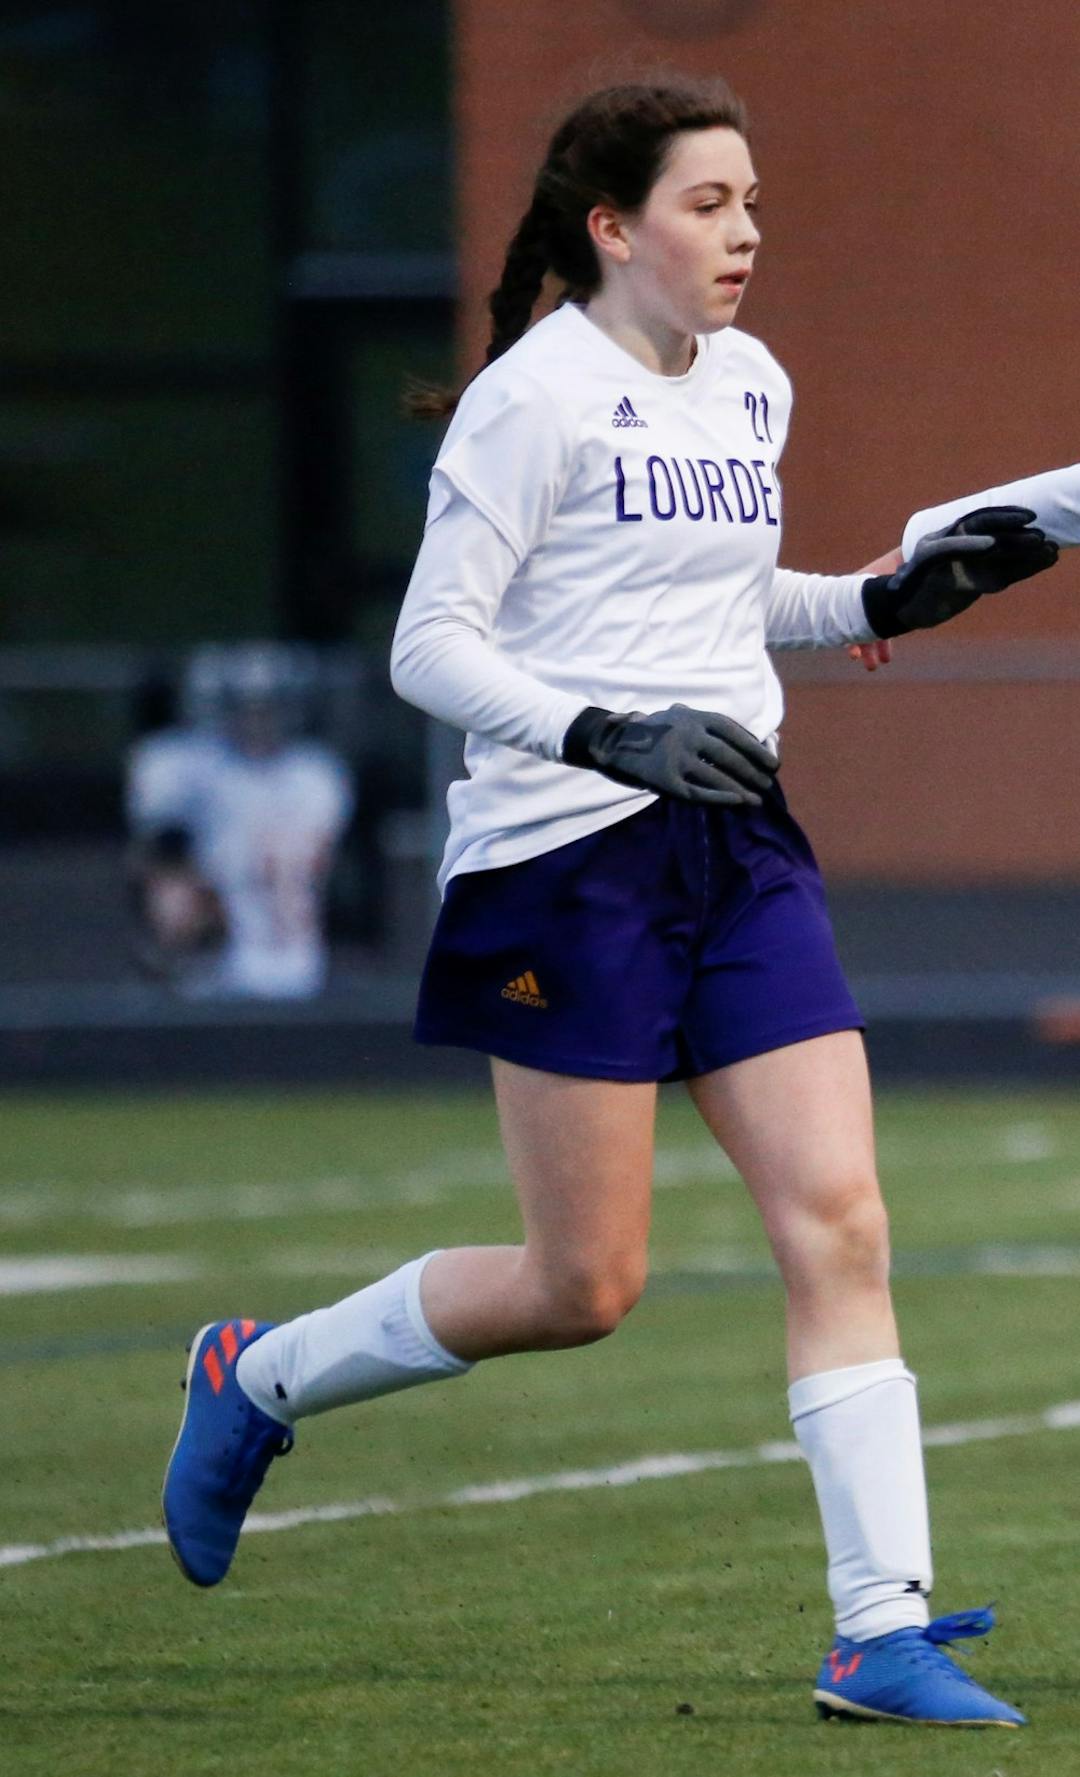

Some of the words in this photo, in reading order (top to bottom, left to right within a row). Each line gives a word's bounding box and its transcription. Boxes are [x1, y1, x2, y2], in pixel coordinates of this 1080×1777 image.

[612, 416, 649, 429] adidas
[744, 391, 773, 443] 21
[614, 455, 780, 526] LOURDE
